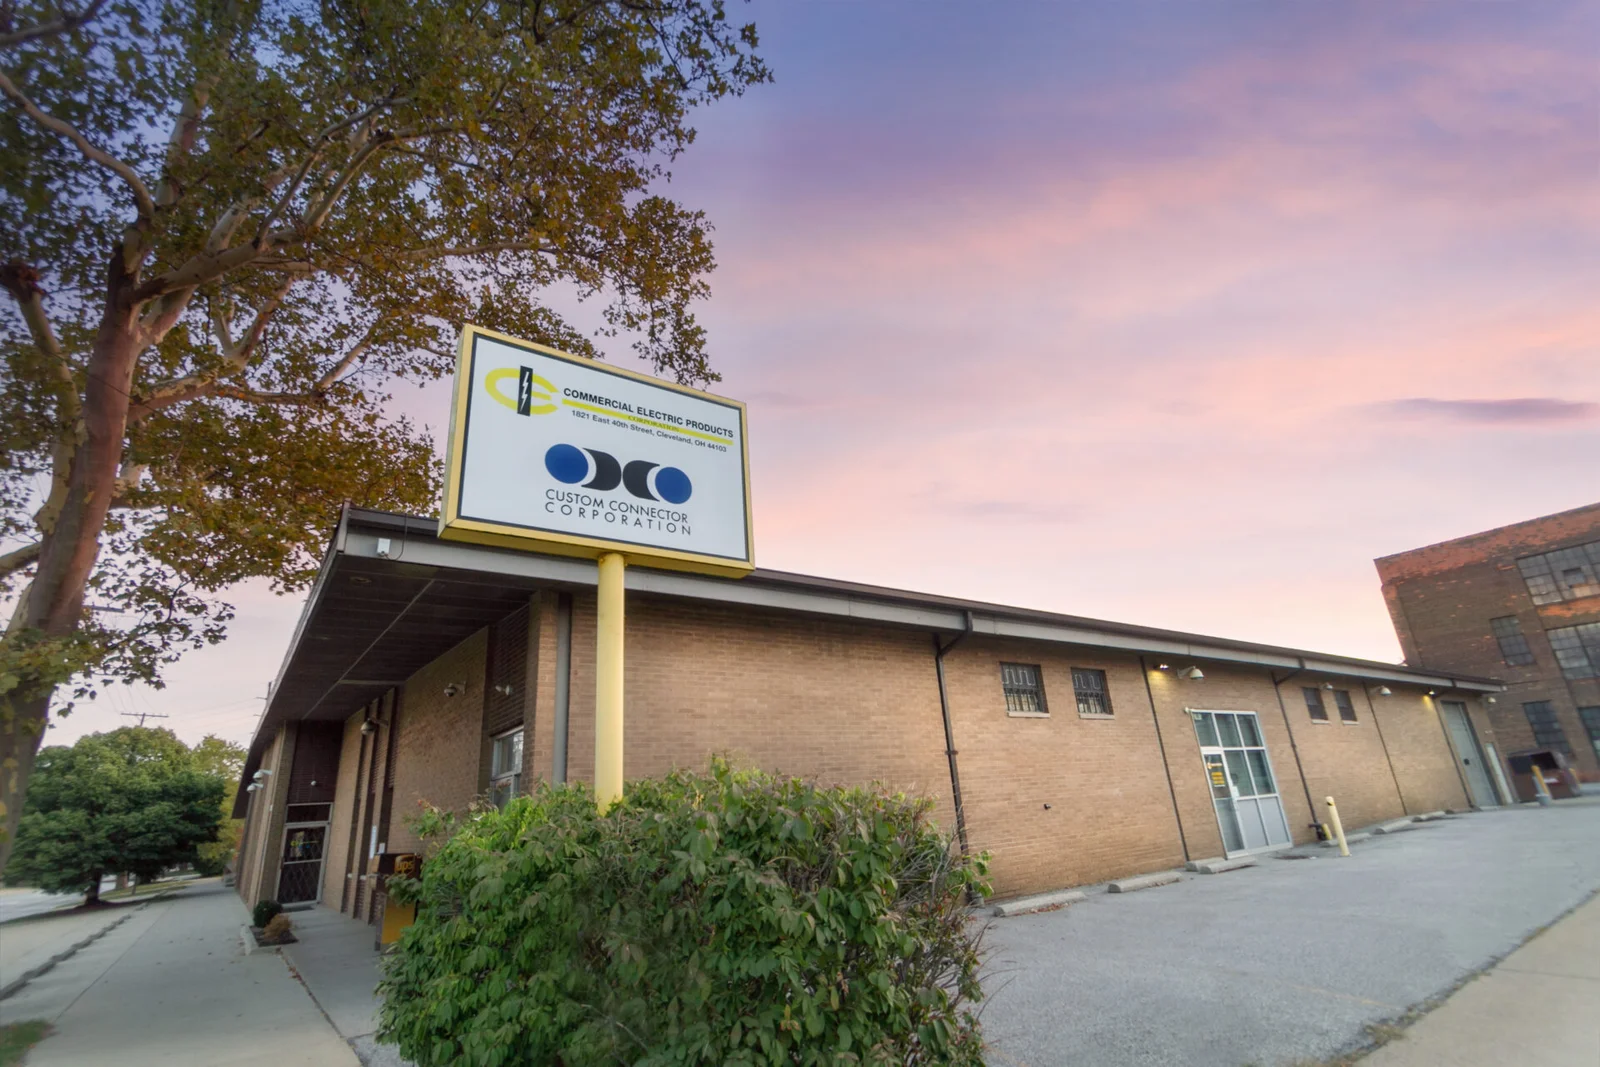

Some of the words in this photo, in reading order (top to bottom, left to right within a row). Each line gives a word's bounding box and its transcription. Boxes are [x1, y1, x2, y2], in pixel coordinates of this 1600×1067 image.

[563, 387, 634, 413] COMMERCIAL
[637, 406, 683, 425] ELECTRIC
[685, 419, 734, 438] PRODUCTS
[571, 410, 590, 420] 1821
[592, 414, 610, 425] East
[612, 419, 629, 429] 40th
[630, 423, 655, 436] Street,
[656, 430, 693, 445] Cleveland,
[694, 439, 706, 447] OH
[707, 444, 727, 452] 44103
[544, 501, 691, 535] CORPORATION
[545, 488, 604, 508] CUSTOM
[609, 500, 688, 523] CONNECTOR
